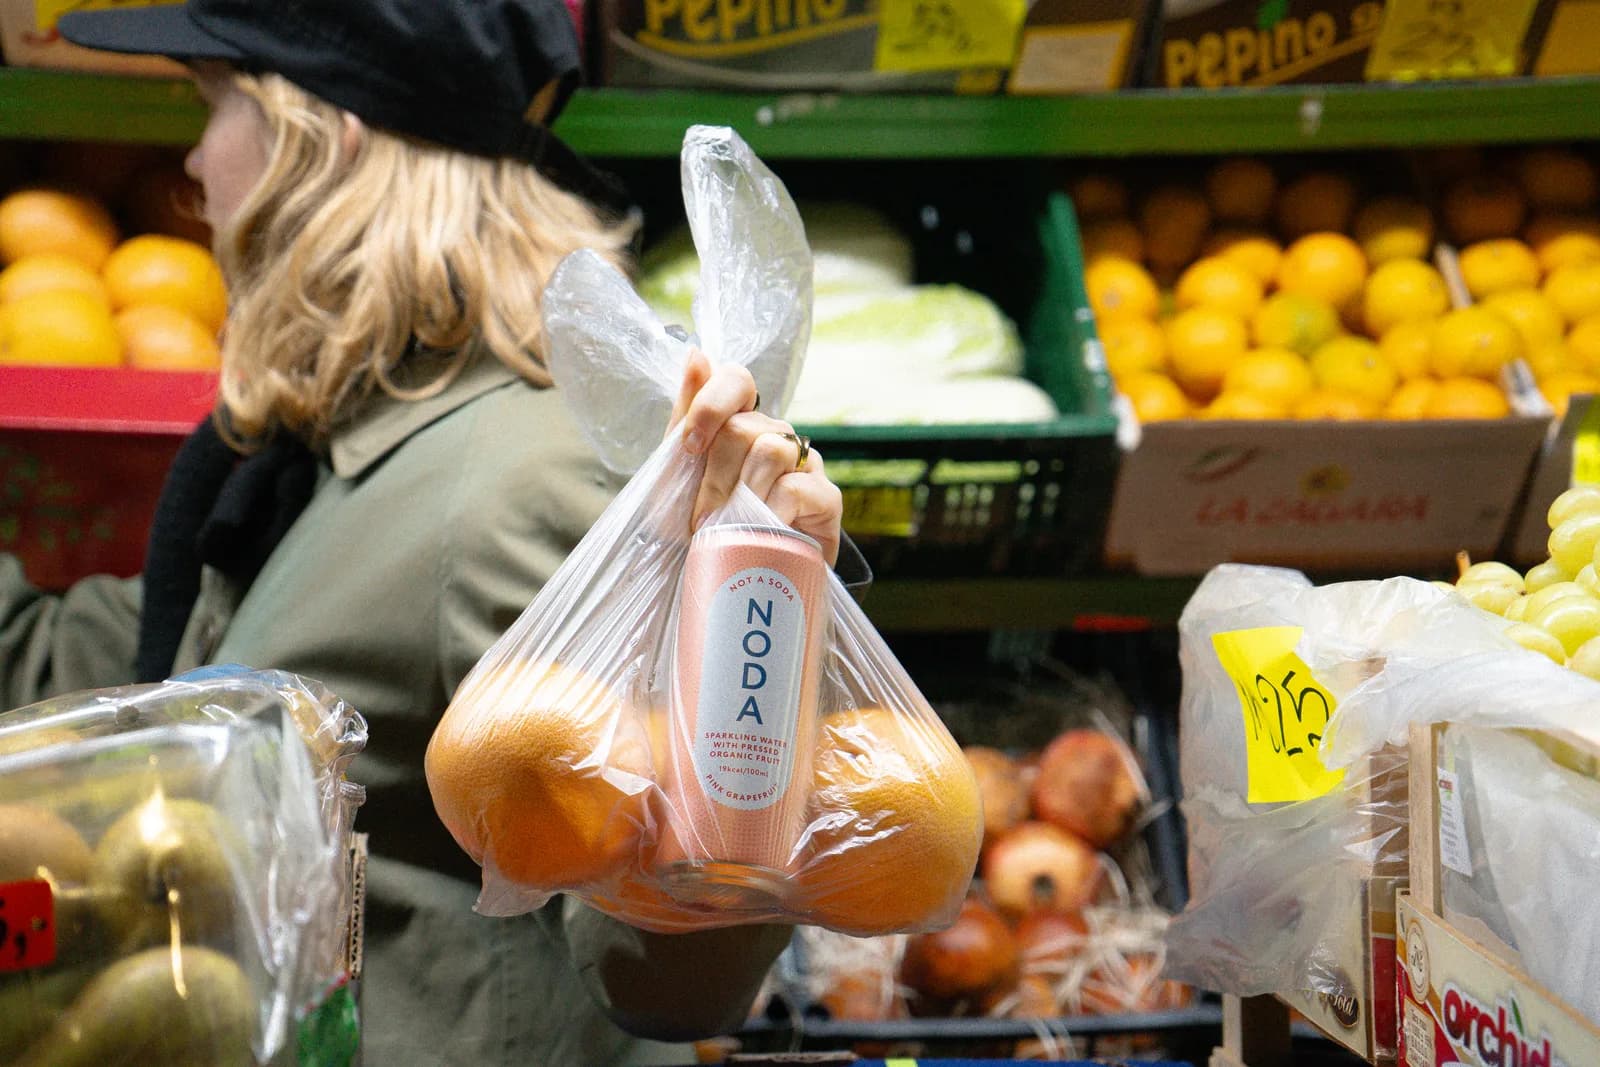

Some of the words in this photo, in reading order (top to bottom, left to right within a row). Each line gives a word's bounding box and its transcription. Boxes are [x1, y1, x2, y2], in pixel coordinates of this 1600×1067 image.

[730, 576, 752, 592] NOT
[757, 576, 764, 584] A
[769, 578, 794, 602] SODA
[736, 598, 773, 725] NODA
[705, 732, 757, 742] SPARKLING
[760, 736, 787, 748] WATER
[713, 741, 738, 749] WITH
[741, 743, 779, 756] PRESSED
[709, 751, 753, 761] ORGANIC
[756, 755, 780, 766] FRUIT
[706, 774, 724, 793] PINK
